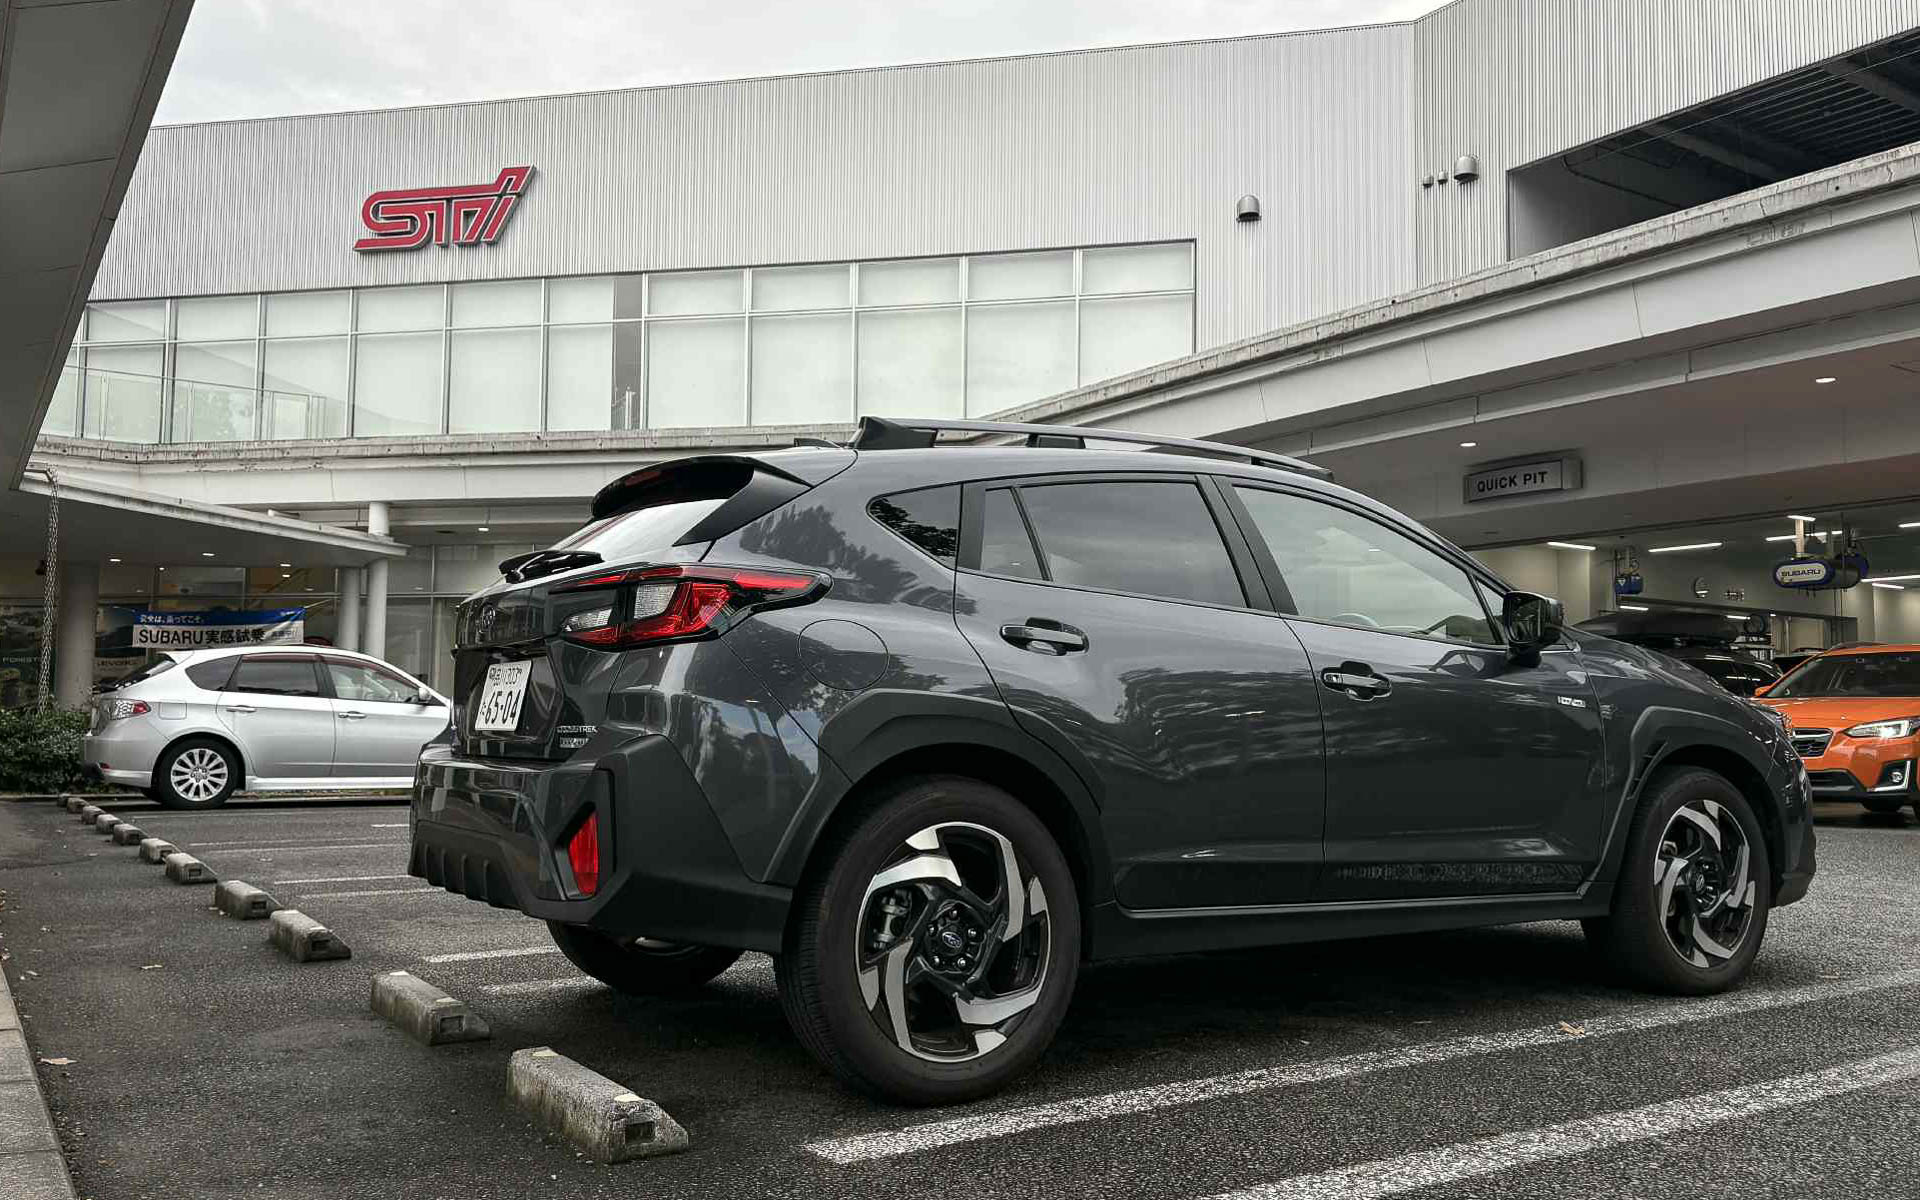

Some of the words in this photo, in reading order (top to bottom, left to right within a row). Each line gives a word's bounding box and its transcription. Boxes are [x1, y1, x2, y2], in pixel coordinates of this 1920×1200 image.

[1477, 475, 1517, 492] QUICK
[1523, 471, 1548, 485] PIT
[1781, 569, 1821, 577] SUBARU
[485, 690, 521, 724] 65-04
